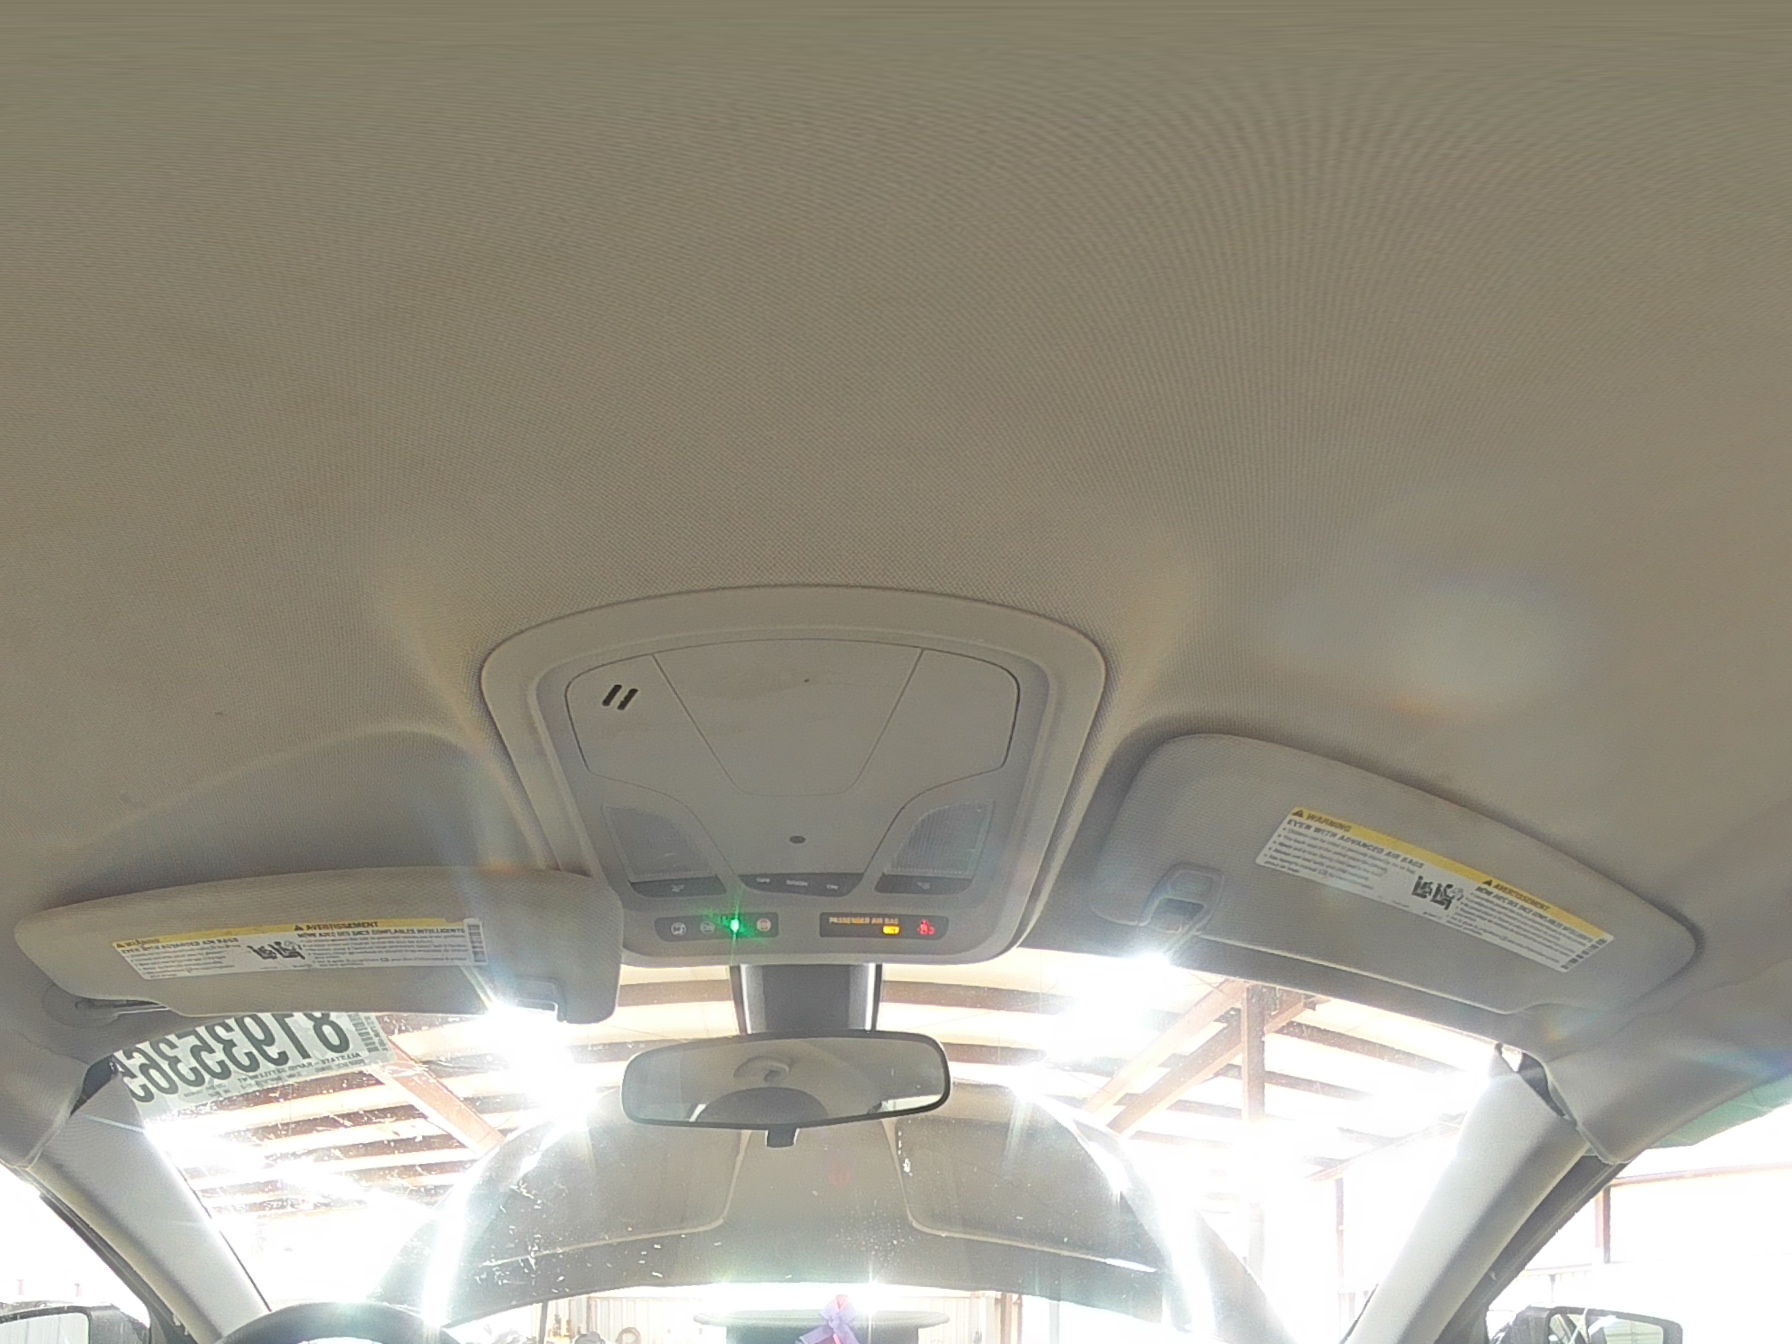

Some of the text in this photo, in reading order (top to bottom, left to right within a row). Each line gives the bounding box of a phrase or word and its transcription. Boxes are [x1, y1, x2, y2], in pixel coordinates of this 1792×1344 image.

[1306, 814, 1352, 832] WARNING
[1287, 819, 1425, 869] EVEN WITH ADVANCED AIR BAGS
